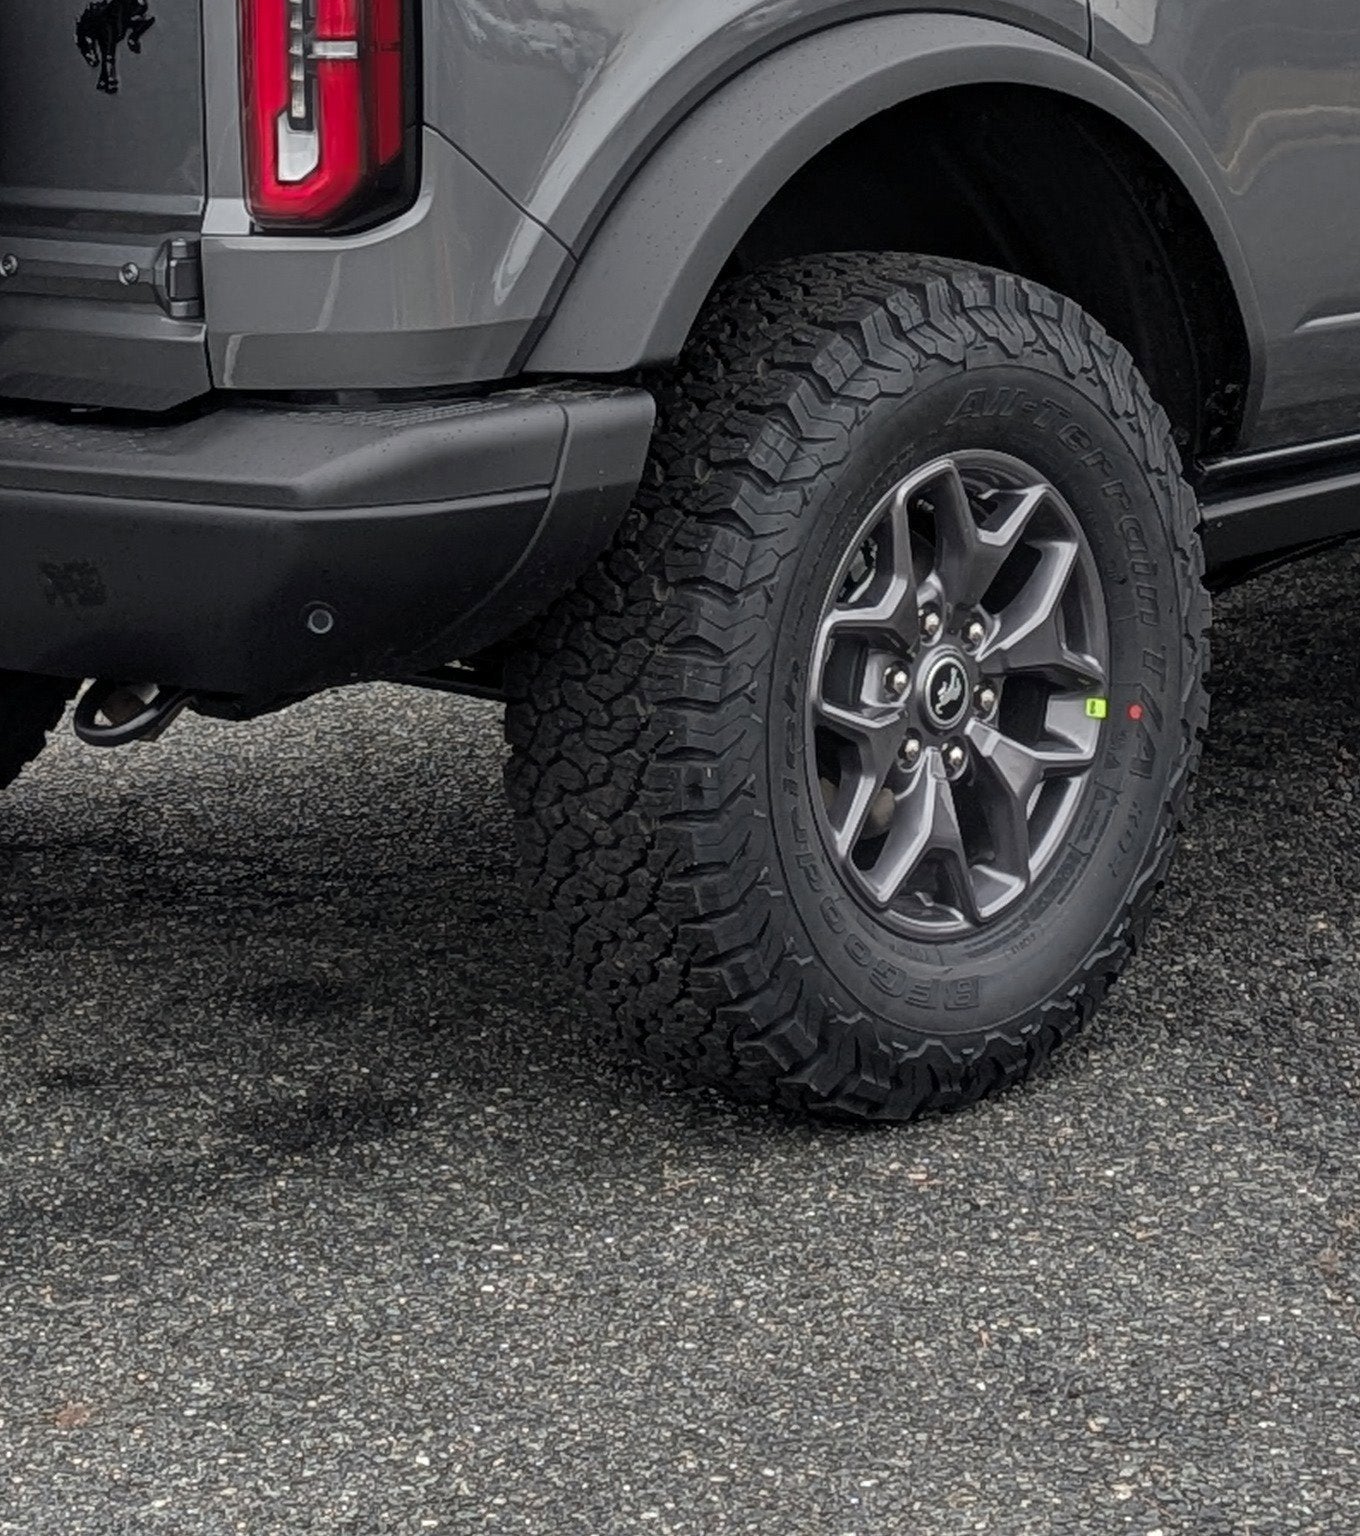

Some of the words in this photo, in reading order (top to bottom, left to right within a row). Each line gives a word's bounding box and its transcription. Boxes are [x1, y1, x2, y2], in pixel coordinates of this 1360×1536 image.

[944, 387, 1160, 627] All-Terrain
[1131, 645, 1168, 780] T/A
[781, 659, 981, 1011] BFGoodrich
